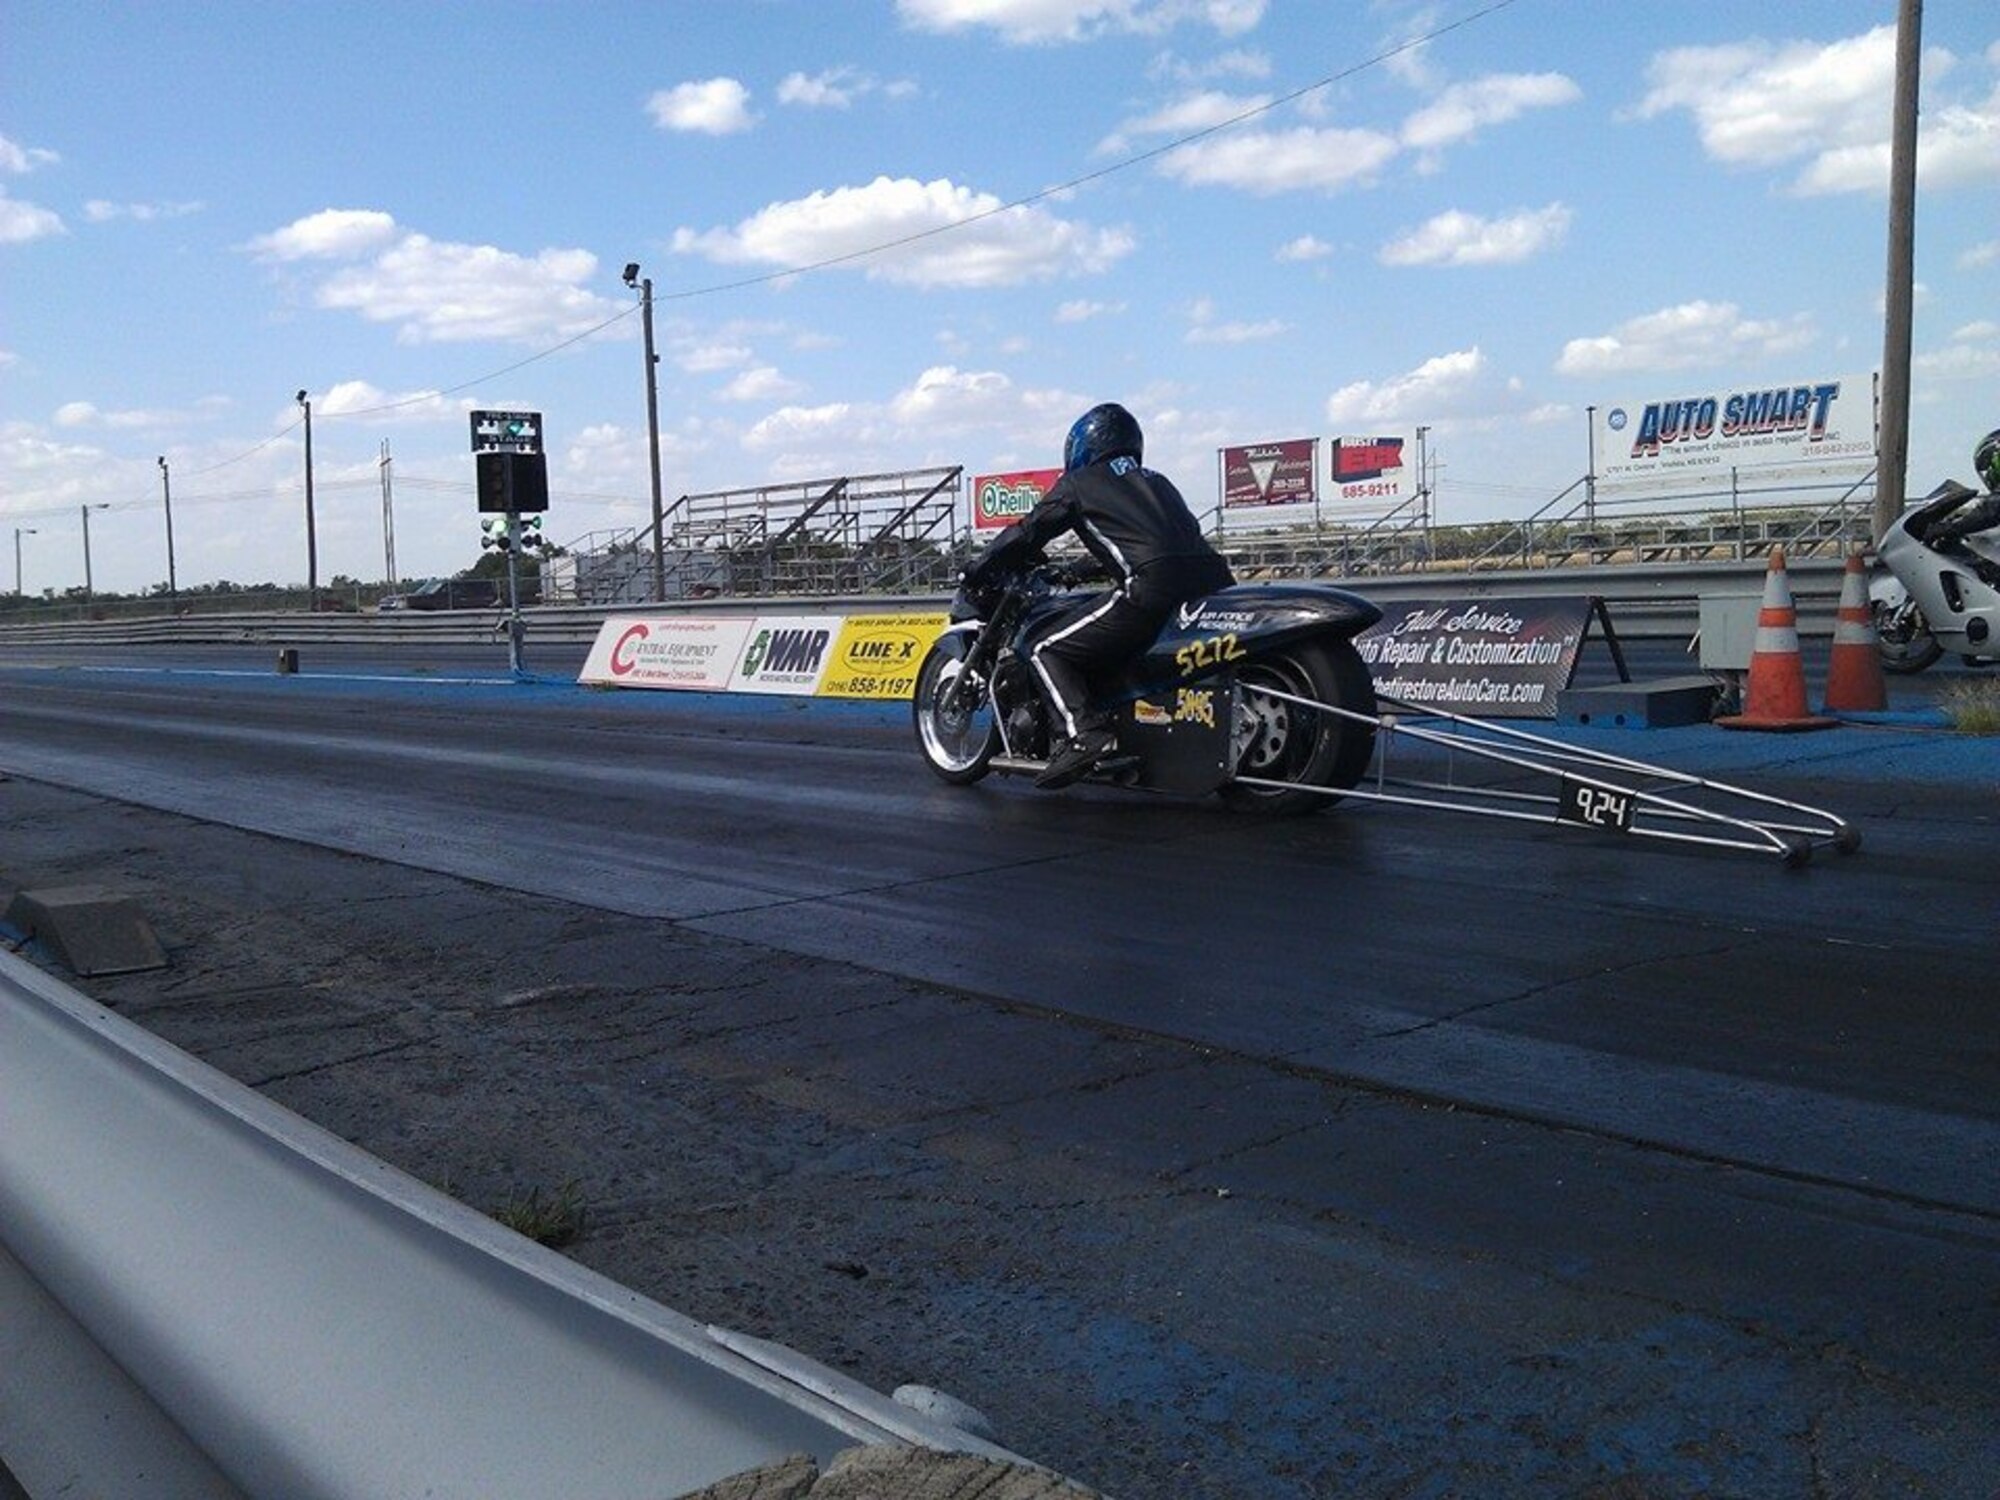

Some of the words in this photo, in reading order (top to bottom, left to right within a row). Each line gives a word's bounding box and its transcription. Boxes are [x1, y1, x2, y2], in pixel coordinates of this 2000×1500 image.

[1631, 397, 1719, 459] AUTO
[1721, 382, 1840, 441] SMART
[1342, 483, 1398, 498] 685-9211
[1198, 622, 1248, 630] RESERVE
[1218, 612, 1255, 620] FORCE
[1393, 608, 1449, 636] Full
[1442, 606, 1524, 634] Service
[763, 630, 830, 673] WMR
[1379, 637, 1431, 668] Repair
[1431, 637, 1446, 663] &
[849, 677, 913, 694] 858-1197
